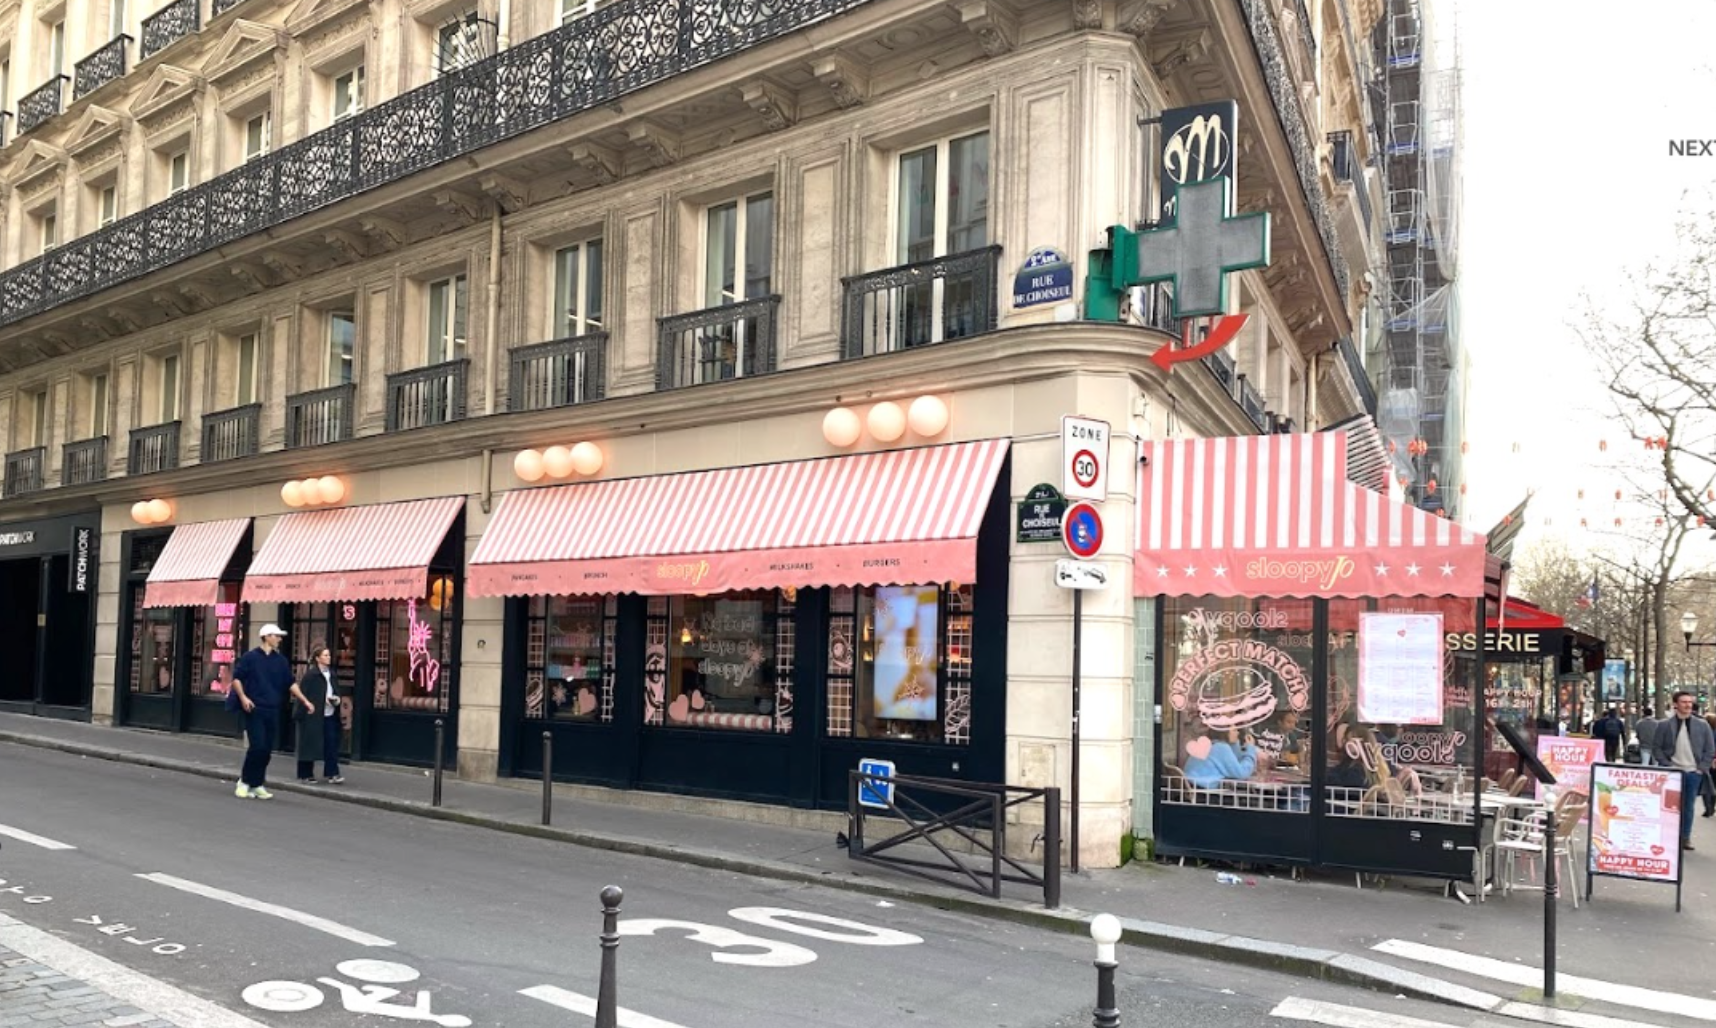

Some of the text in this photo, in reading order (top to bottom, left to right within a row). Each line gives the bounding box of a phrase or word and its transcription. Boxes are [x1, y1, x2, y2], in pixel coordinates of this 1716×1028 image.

[1032, 274, 1054, 288] RUE
[1026, 285, 1071, 302] CHOISEUL
[1072, 425, 1102, 441] ZONE
[1077, 460, 1094, 477] 30
[1034, 503, 1050, 514] RUE
[76, 529, 90, 591] PATCHWORK
[863, 558, 901, 568] BURGERS
[1445, 633, 1541, 652] SSERIE
[1172, 640, 1306, 693] PERFECT MATCH
[1484, 688, 1509, 697] APPY
[1552, 746, 1589, 755] HAPPY
[1554, 754, 1586, 763] HOUR
[1616, 779, 1650, 788] DEALS
[1600, 856, 1634, 865] HAPPY
[1637, 859, 1669, 869] HOUR
[617, 906, 925, 968] 30
